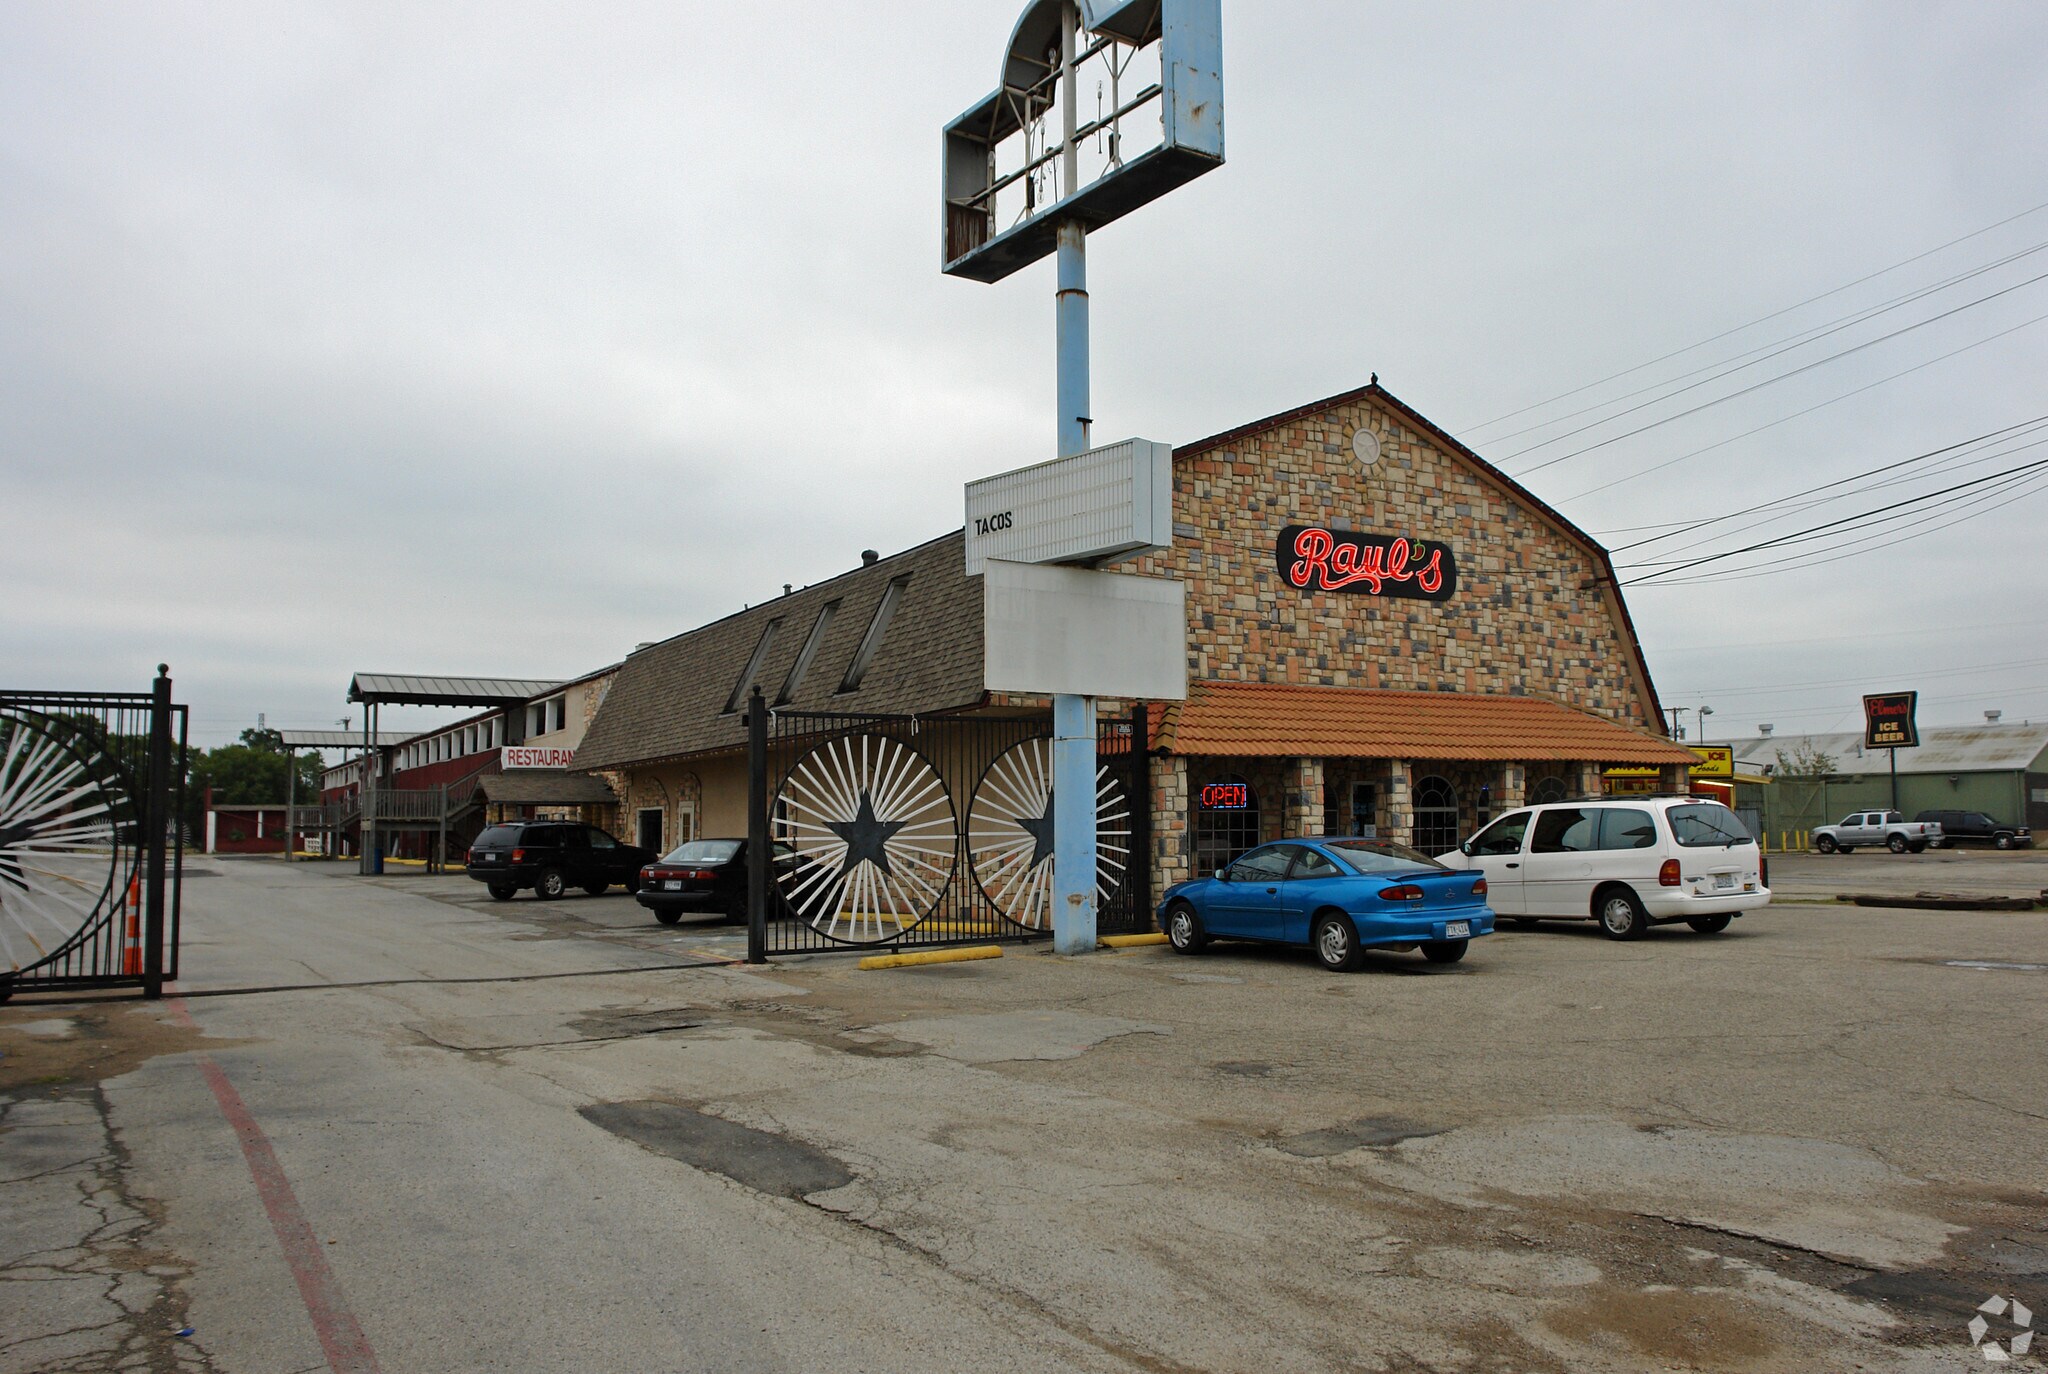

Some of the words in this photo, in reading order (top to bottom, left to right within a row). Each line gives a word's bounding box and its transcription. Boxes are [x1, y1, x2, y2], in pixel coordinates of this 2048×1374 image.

[975, 511, 1012, 535] TACOS
[1290, 527, 1442, 594] Raul's
[1879, 722, 1899, 731] ICE
[1875, 732, 1904, 742] BEER
[1708, 752, 1725, 760] ICE
[1202, 786, 1245, 806] OPEN
